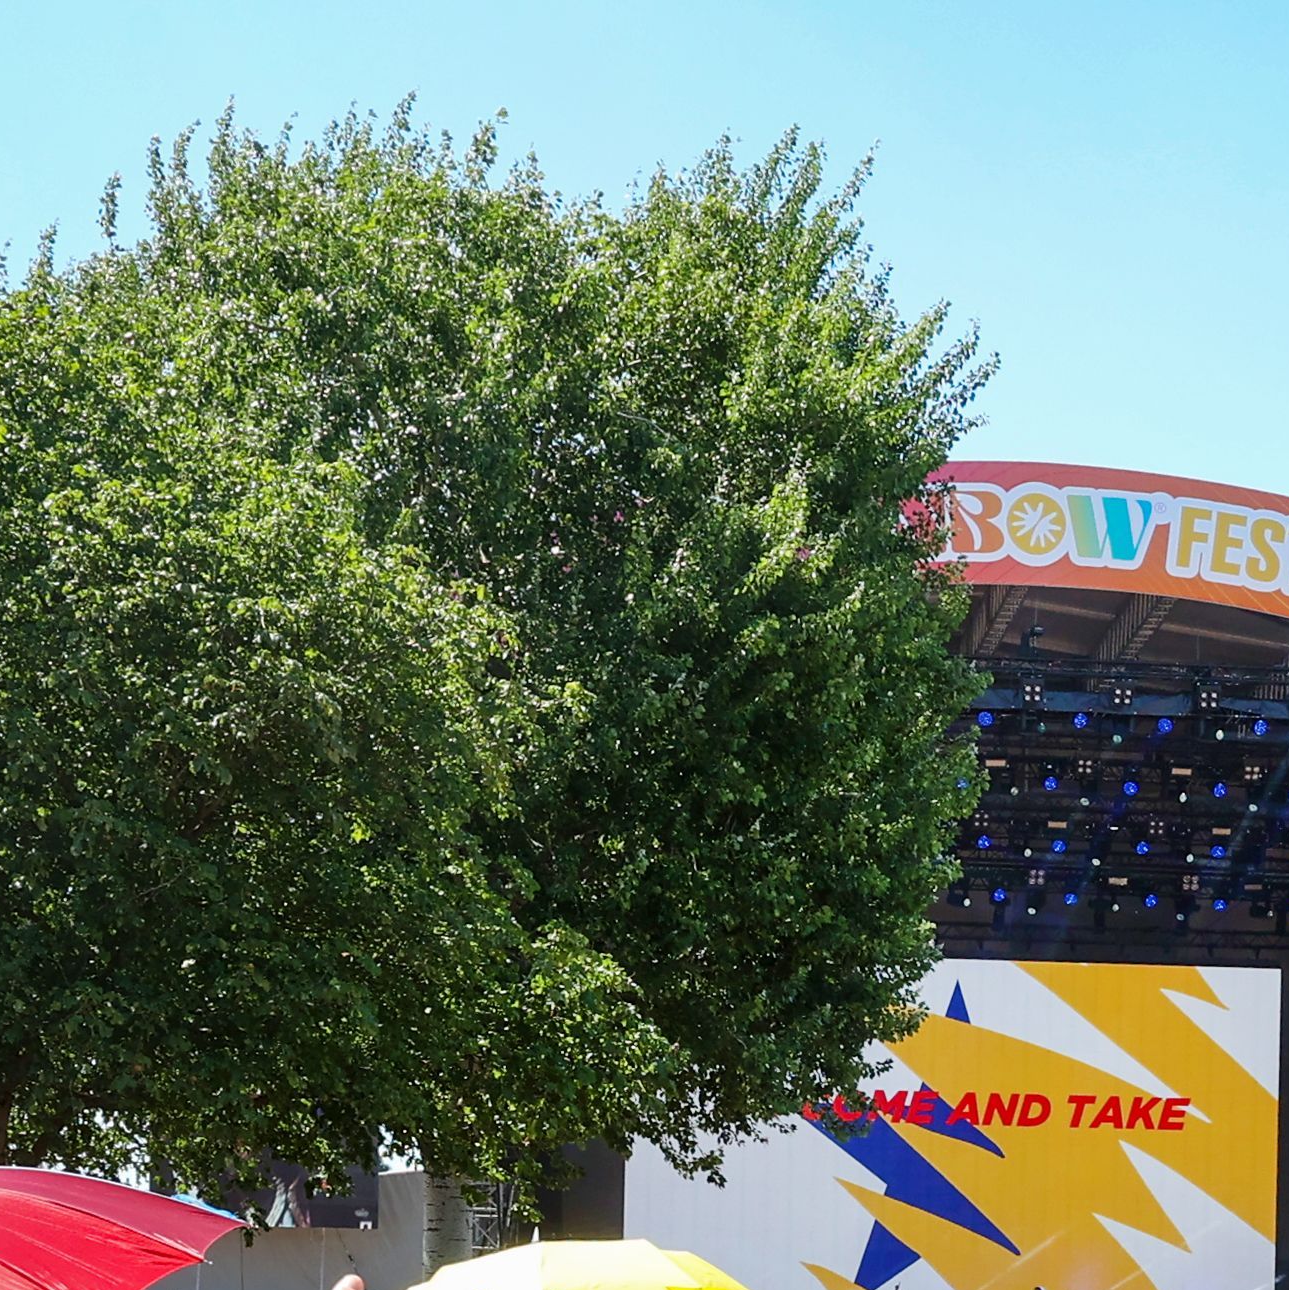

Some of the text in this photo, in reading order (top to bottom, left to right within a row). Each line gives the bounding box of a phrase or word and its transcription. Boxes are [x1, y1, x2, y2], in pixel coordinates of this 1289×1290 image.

[948, 490, 1153, 562] BOW
[946, 1093, 1051, 1127] AND
[1067, 1095, 1191, 1130] TAKE
